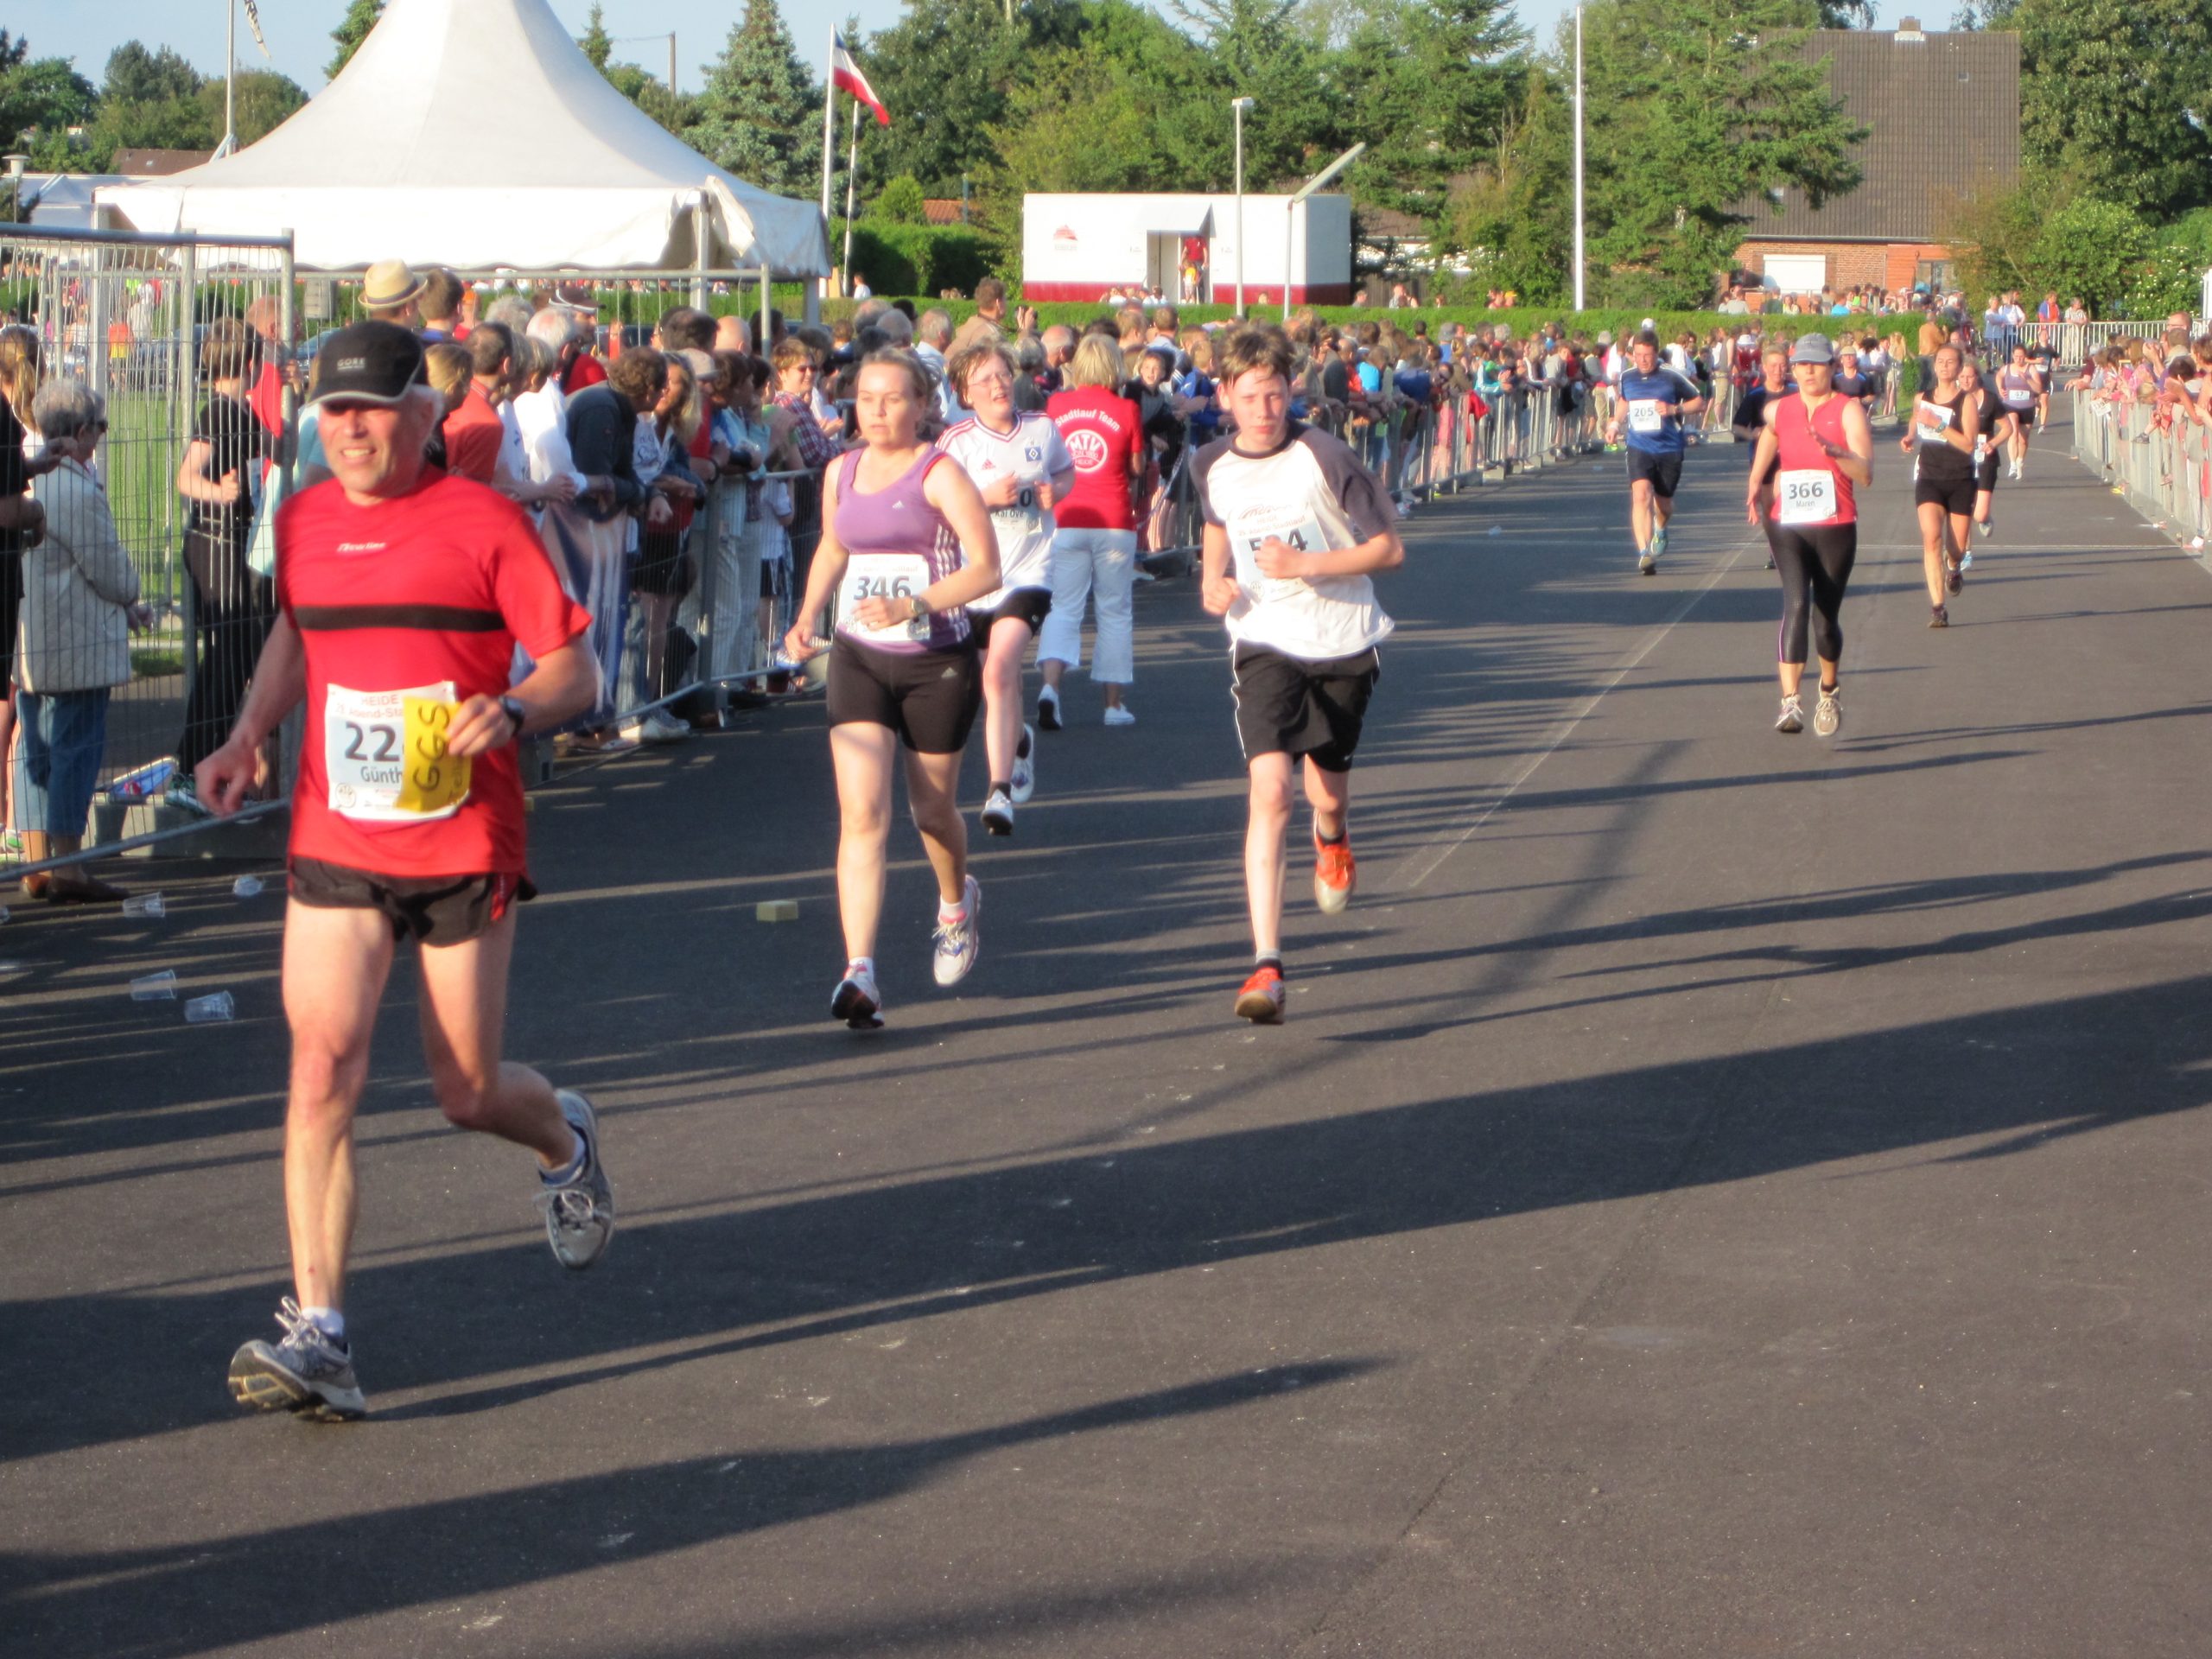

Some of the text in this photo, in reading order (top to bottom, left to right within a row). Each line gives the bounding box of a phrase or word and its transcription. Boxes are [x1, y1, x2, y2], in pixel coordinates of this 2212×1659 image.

[1055, 409, 1121, 431] Stadtlauf Team
[1634, 407, 1654, 416] 205
[1070, 435, 1101, 451] MTV
[1789, 481, 1824, 499] 366
[854, 575, 912, 601] 346
[361, 694, 399, 706] HEIDE
